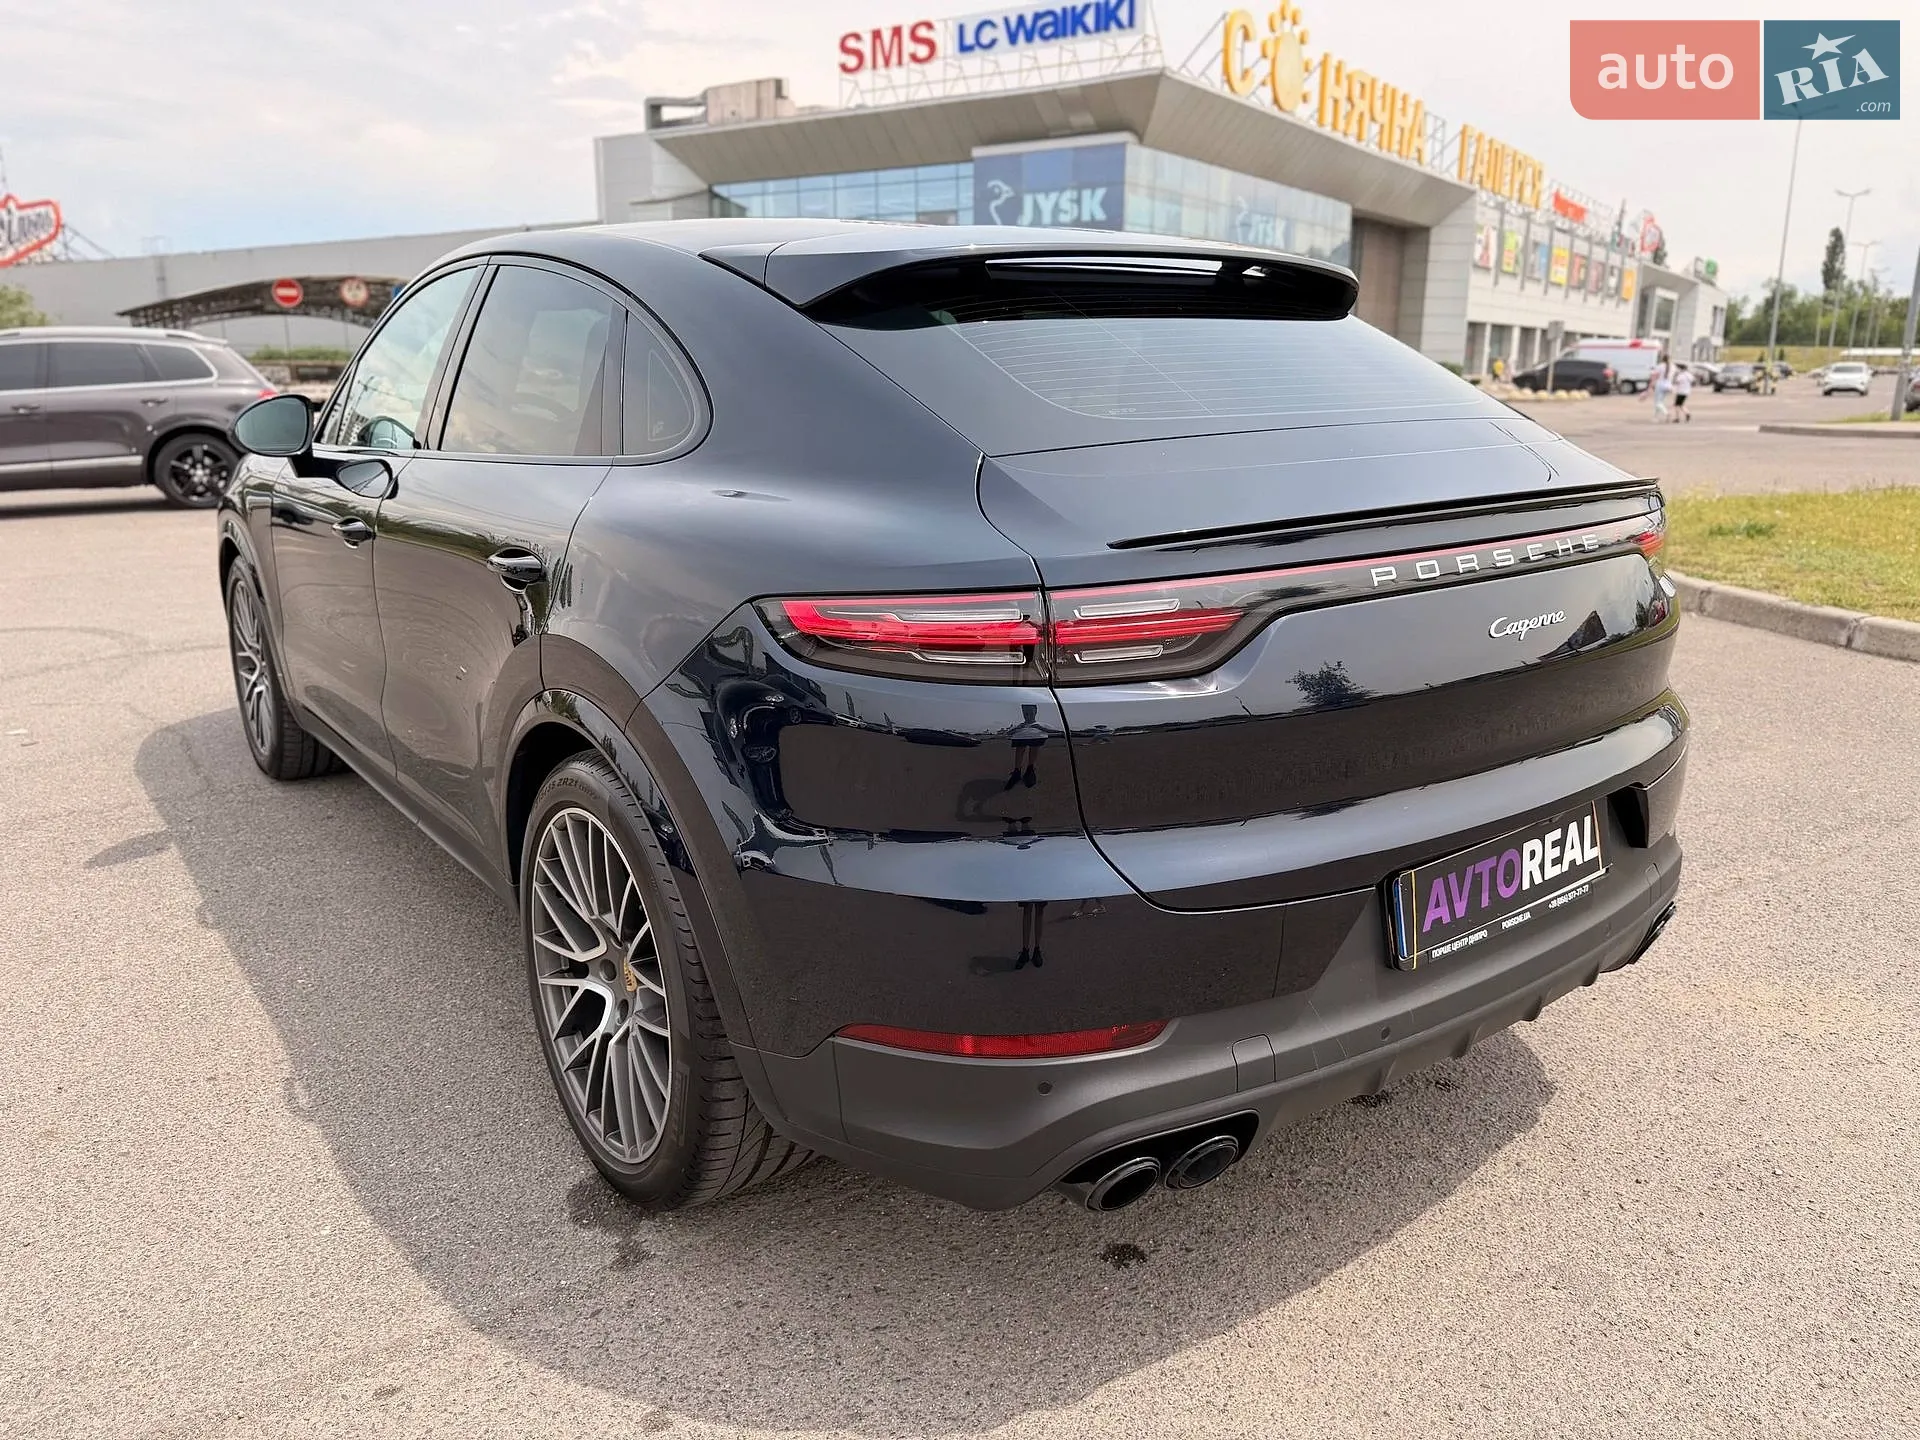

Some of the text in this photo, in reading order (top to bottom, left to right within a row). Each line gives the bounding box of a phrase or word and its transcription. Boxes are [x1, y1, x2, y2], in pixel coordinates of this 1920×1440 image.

[838, 19, 938, 75] SMS
[958, 19, 999, 54] LC
[1457, 123, 1544, 210] ГАЛЕРЕЯ
[1017, 186, 1108, 227] JYSK
[1370, 533, 1600, 587] PORSCHE
[1489, 609, 1566, 640] Cayenne
[1422, 814, 1600, 933] AVTOREAL
